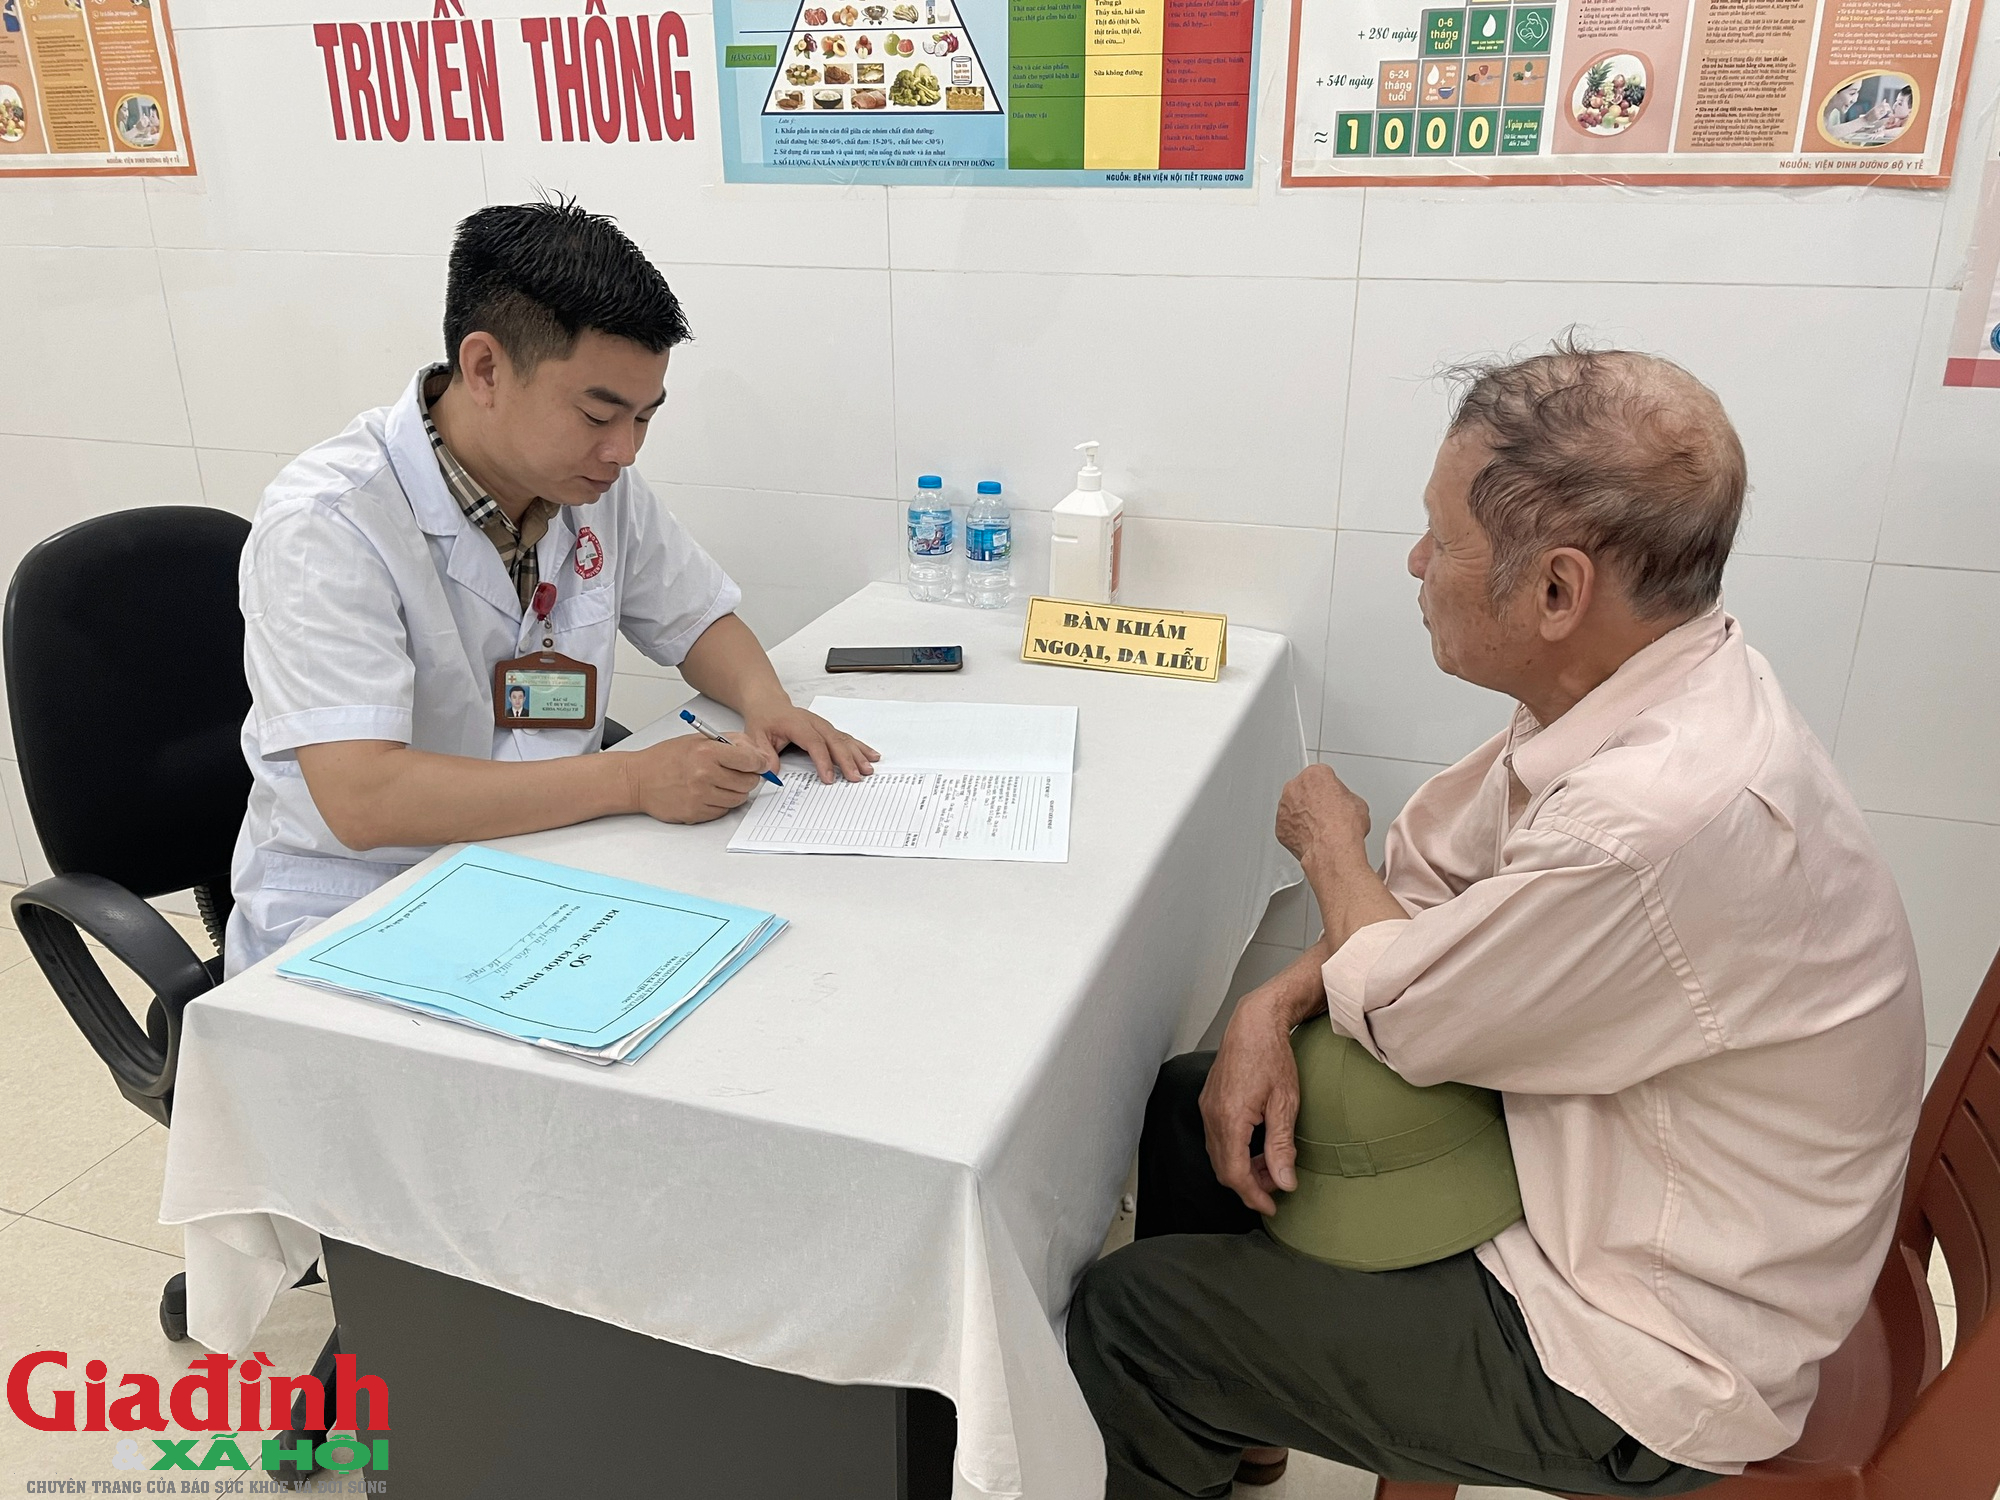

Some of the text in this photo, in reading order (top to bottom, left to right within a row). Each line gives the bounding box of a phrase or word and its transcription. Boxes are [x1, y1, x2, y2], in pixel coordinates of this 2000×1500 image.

[1438, 18, 1453, 27] 0-6
[1368, 28, 1390, 40] 280
[1391, 29, 1418, 43] ngày
[1430, 29, 1458, 41] tháng
[1434, 38, 1453, 50] tuổi
[313, 0, 504, 141] TRUYỀN
[520, 0, 695, 144] THÔNG
[1389, 70, 1409, 79] 6-24
[1327, 74, 1346, 87] 540
[1348, 75, 1374, 89] ngày
[1385, 80, 1412, 92] tháng
[1388, 89, 1406, 101] tuổi
[1347, 116, 1489, 150] 1 0 0 0
[1780, 158, 1811, 169] NGUỒN:
[1815, 160, 1834, 171] VIỆN
[1892, 160, 1903, 171] BỘ
[1915, 159, 1924, 169] TẾ
[1106, 172, 1131, 181] NGUỒN:
[1134, 173, 1150, 182] BỆNH
[1153, 173, 1168, 182] VIỆN
[1170, 173, 1182, 182] NỘI
[1184, 172, 1198, 181] TIẾT
[1063, 611, 1187, 640] BÀN KHÁM
[1033, 638, 1111, 664] NGOẠI,
[1155, 647, 1210, 672] LIỄU
[589, 909, 620, 933] KHÁM
[570, 933, 592, 950] SỨC
[570, 953, 592, 968] SỔ
[516, 972, 544, 991] ĐỊNH
